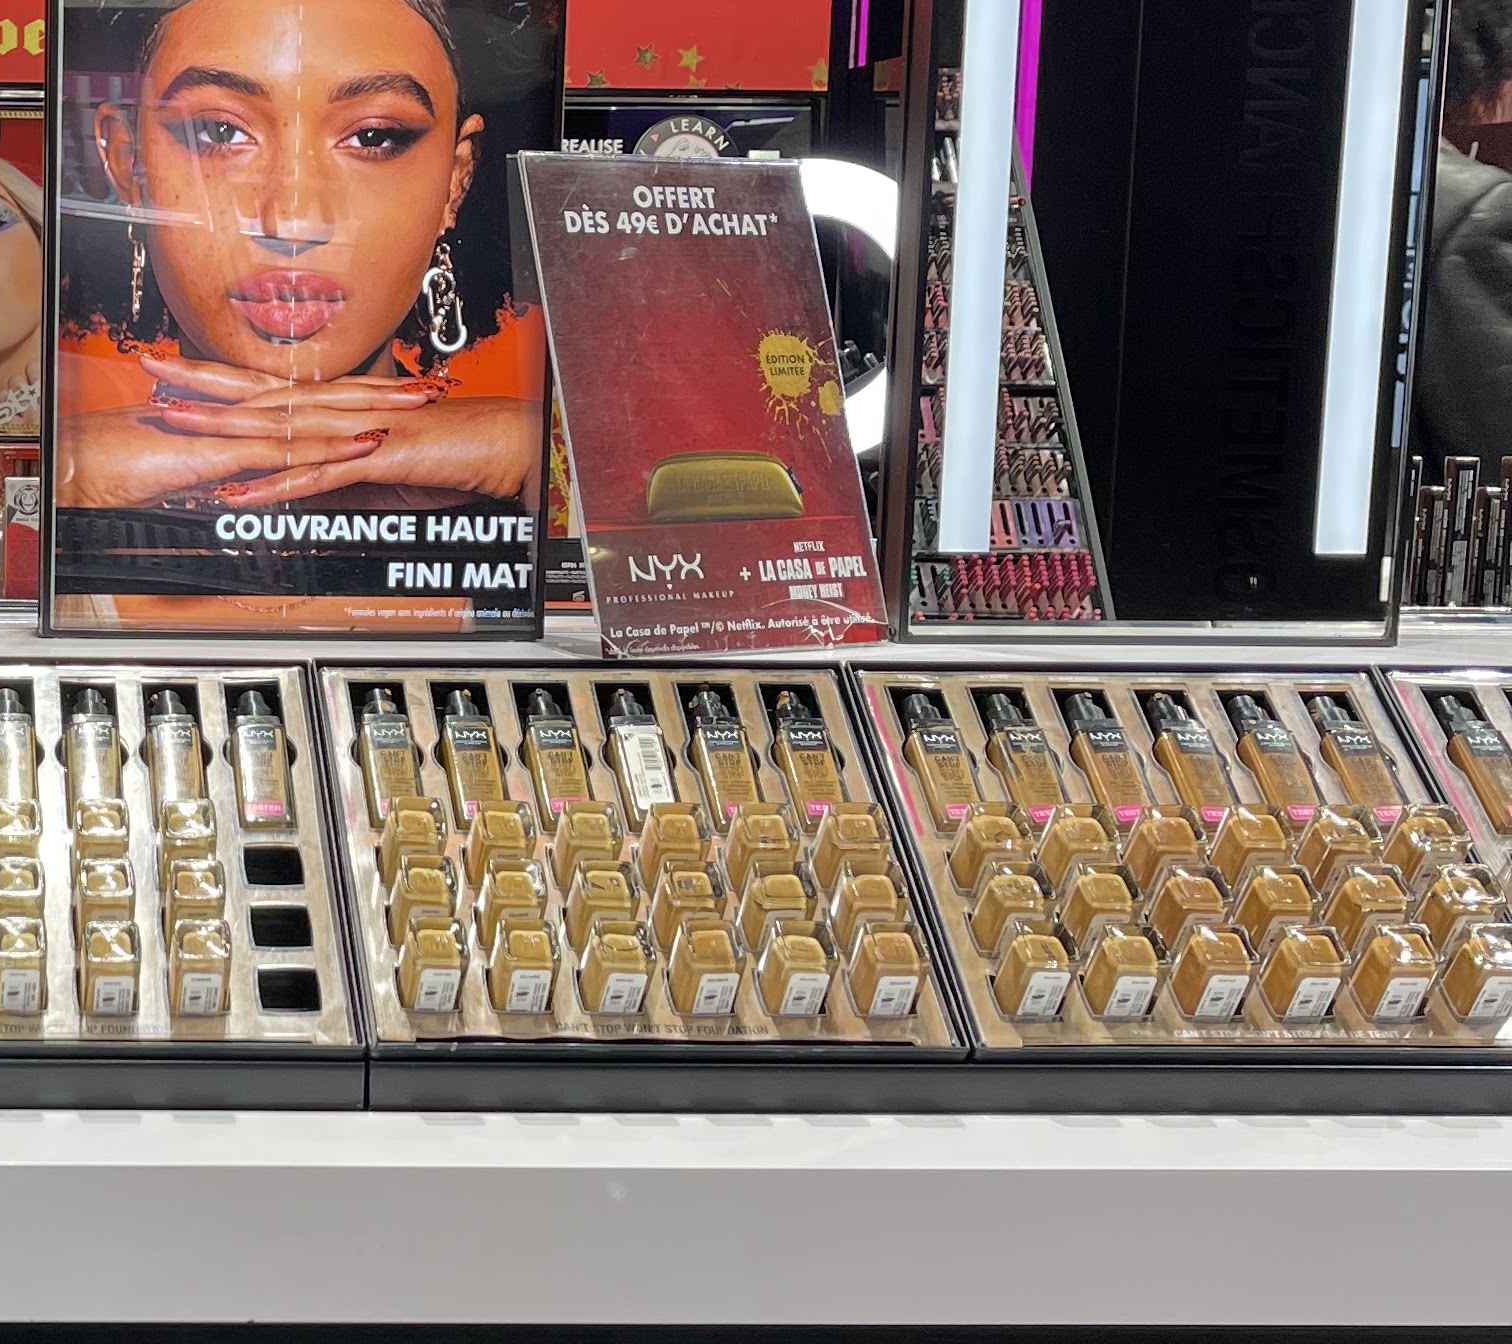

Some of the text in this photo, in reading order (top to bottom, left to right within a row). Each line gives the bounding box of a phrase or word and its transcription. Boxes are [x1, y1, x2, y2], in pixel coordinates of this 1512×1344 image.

[669, 118, 730, 151] LEARN
[633, 185, 715, 209] OFFERT
[564, 204, 610, 235] DÈS
[617, 210, 660, 235] 49€
[215, 514, 533, 542] COUVRANCE HAUTE
[793, 541, 825, 553] NETFLIX
[628, 553, 704, 582] NYX
[758, 559, 776, 582] LA
[776, 558, 813, 580] CASA
[828, 556, 867, 578] PAPEL
[388, 562, 452, 589] FINI
[462, 562, 533, 589] MAT
[606, 590, 735, 604] PROFESSIONAL MAKEUP
[609, 627, 623, 638] La
[626, 625, 650, 637] Casa
[653, 624, 667, 635] de
[670, 623, 700, 639] Papel
[727, 619, 765, 632] Netflix.
[768, 615, 809, 628] Autorisé
[373, 728, 406, 739] NYX
[455, 730, 487, 740] NYX
[540, 728, 572, 739] NYX
[706, 730, 739, 740] NYX
[790, 731, 823, 741] NYX
[923, 734, 956, 744] NYX
[1089, 731, 1122, 741] NYX
[1177, 732, 1210, 743] NYX
[1256, 732, 1289, 743] NYX
[1337, 735, 1372, 745] NYX
[593, 1024, 621, 1033] STOP
[665, 1025, 693, 1034] STOP
